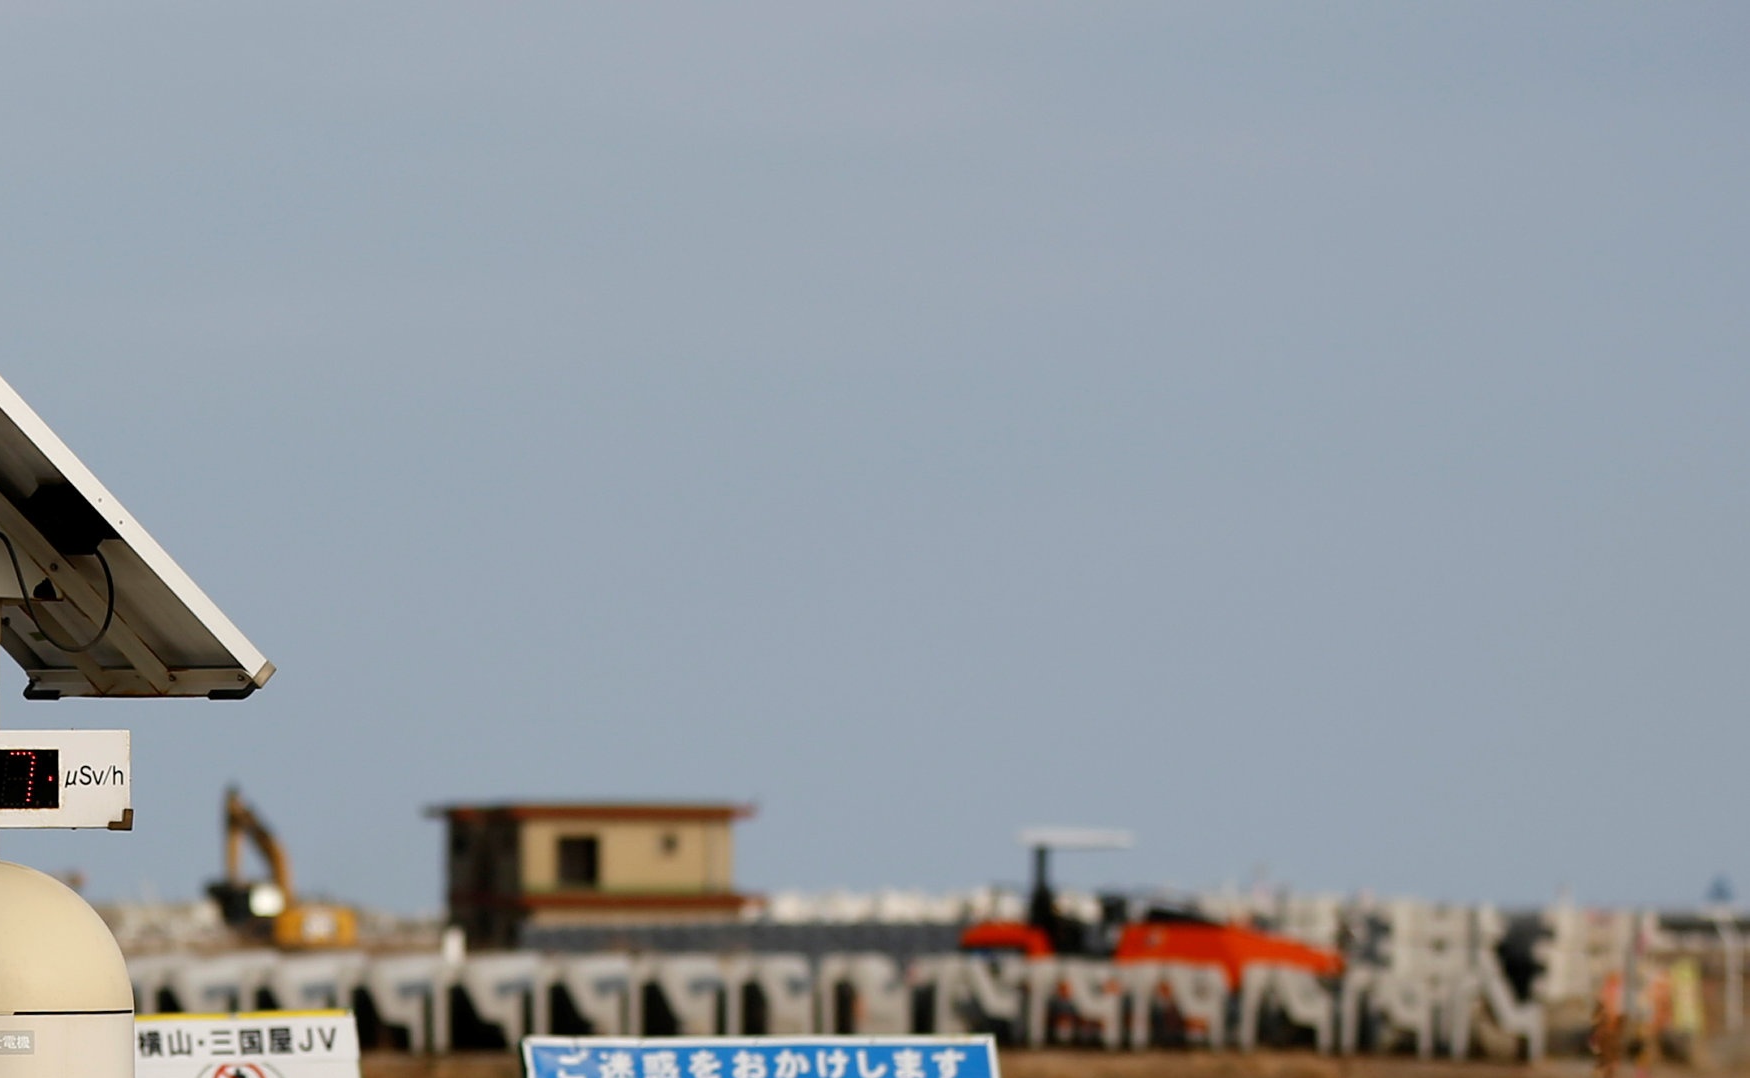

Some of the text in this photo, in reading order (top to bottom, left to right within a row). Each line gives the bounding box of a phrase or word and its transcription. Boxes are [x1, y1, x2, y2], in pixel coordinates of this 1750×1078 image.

[64, 765, 124, 788] μSv/h
[138, 1026, 337, 1056] 横山・三国屋JV
